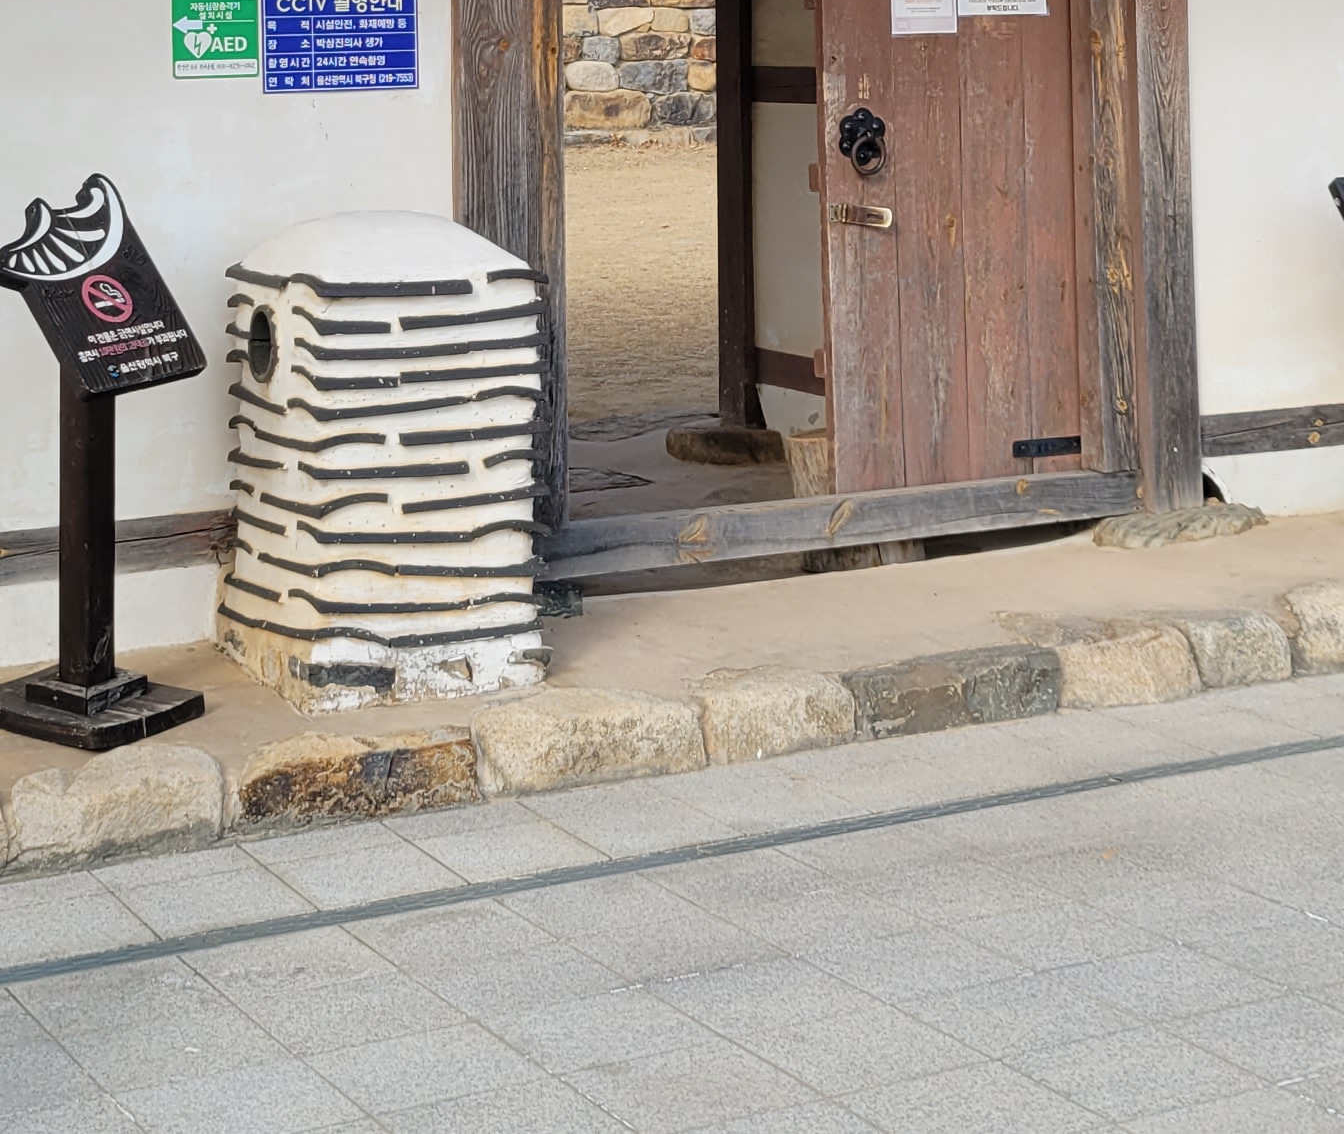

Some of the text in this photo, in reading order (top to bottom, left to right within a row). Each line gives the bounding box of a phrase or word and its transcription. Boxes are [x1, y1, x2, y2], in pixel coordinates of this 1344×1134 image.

[316, 18, 357, 31] 시설안전,
[358, 18, 395, 30] 화재예방
[210, 36, 248, 53] AED
[316, 36, 383, 49] 박상진의사 생가
[316, 56, 347, 67] 24시간
[119, 351, 179, 374] 울산광역시 북구
